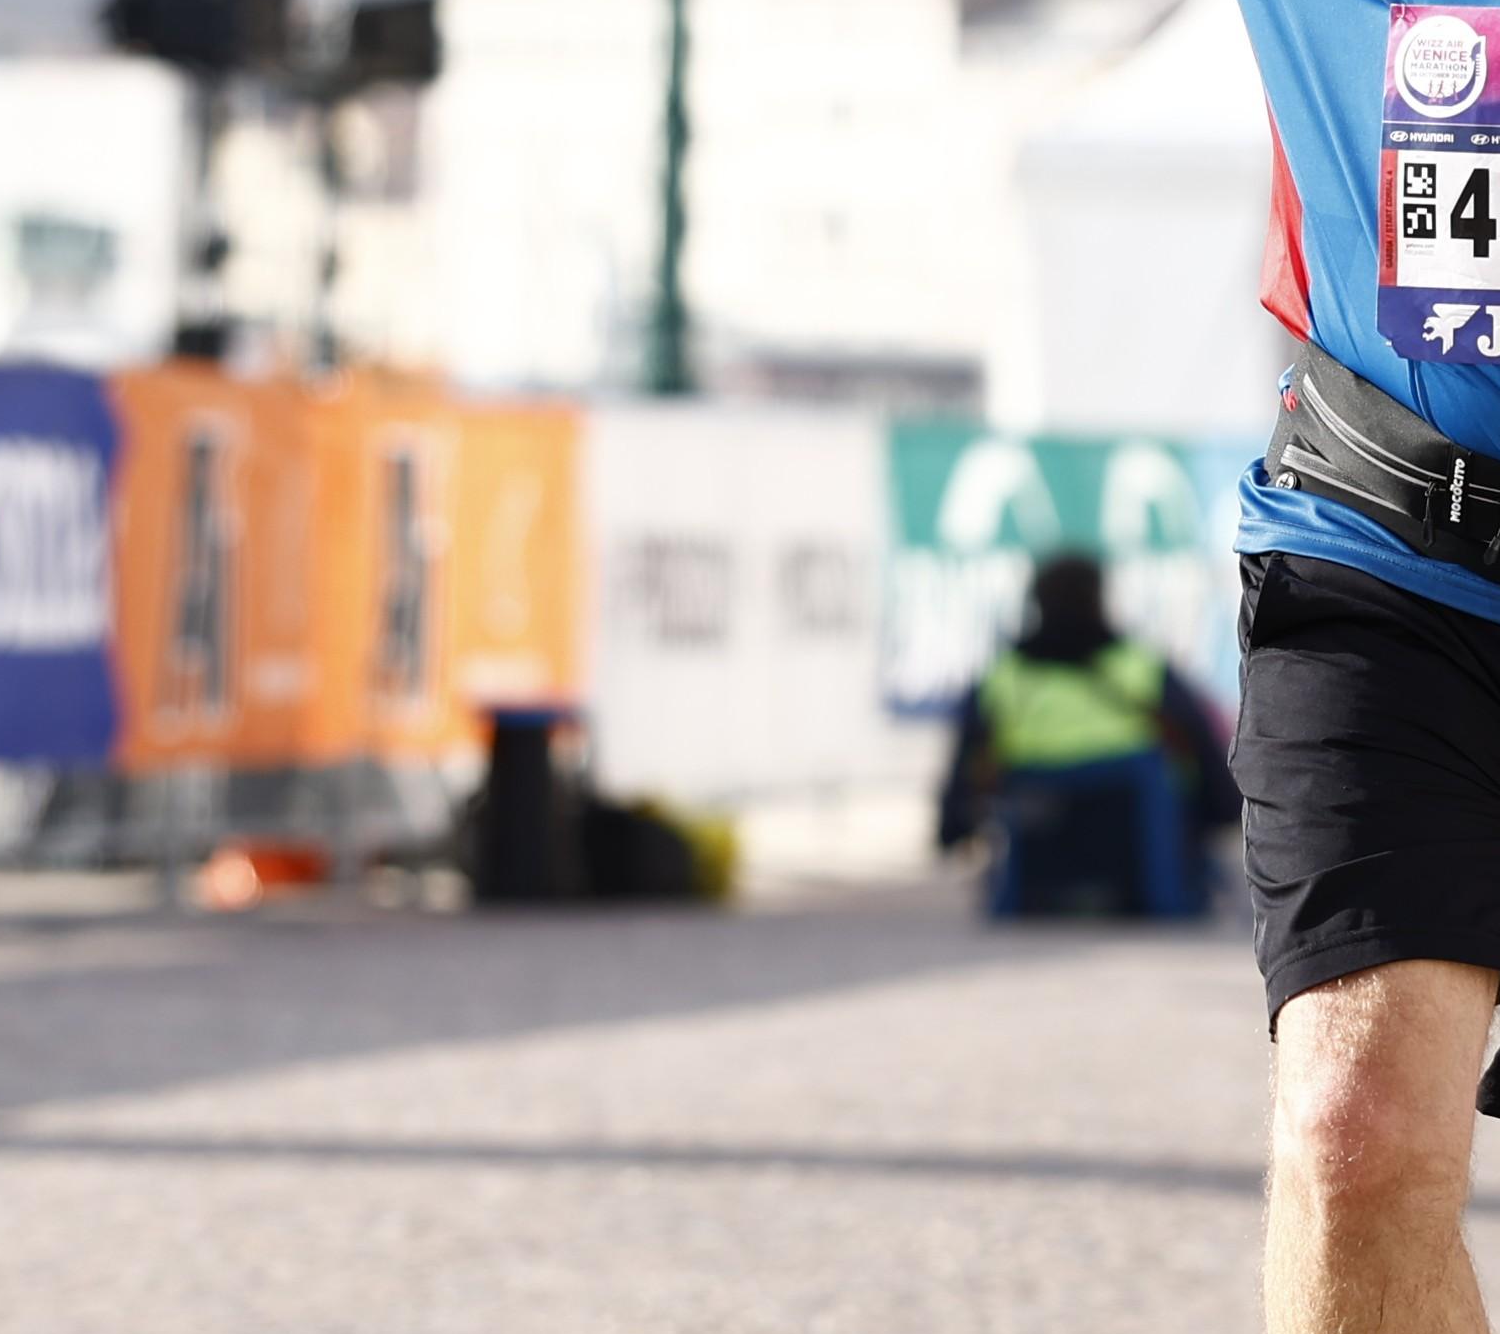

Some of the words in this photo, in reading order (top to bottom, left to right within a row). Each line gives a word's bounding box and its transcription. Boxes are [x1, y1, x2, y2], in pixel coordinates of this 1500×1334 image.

[1412, 49, 1468, 62] VENICE
[1410, 62, 1468, 71] MARATHON
[1410, 132, 1454, 143] HYUNDAI
